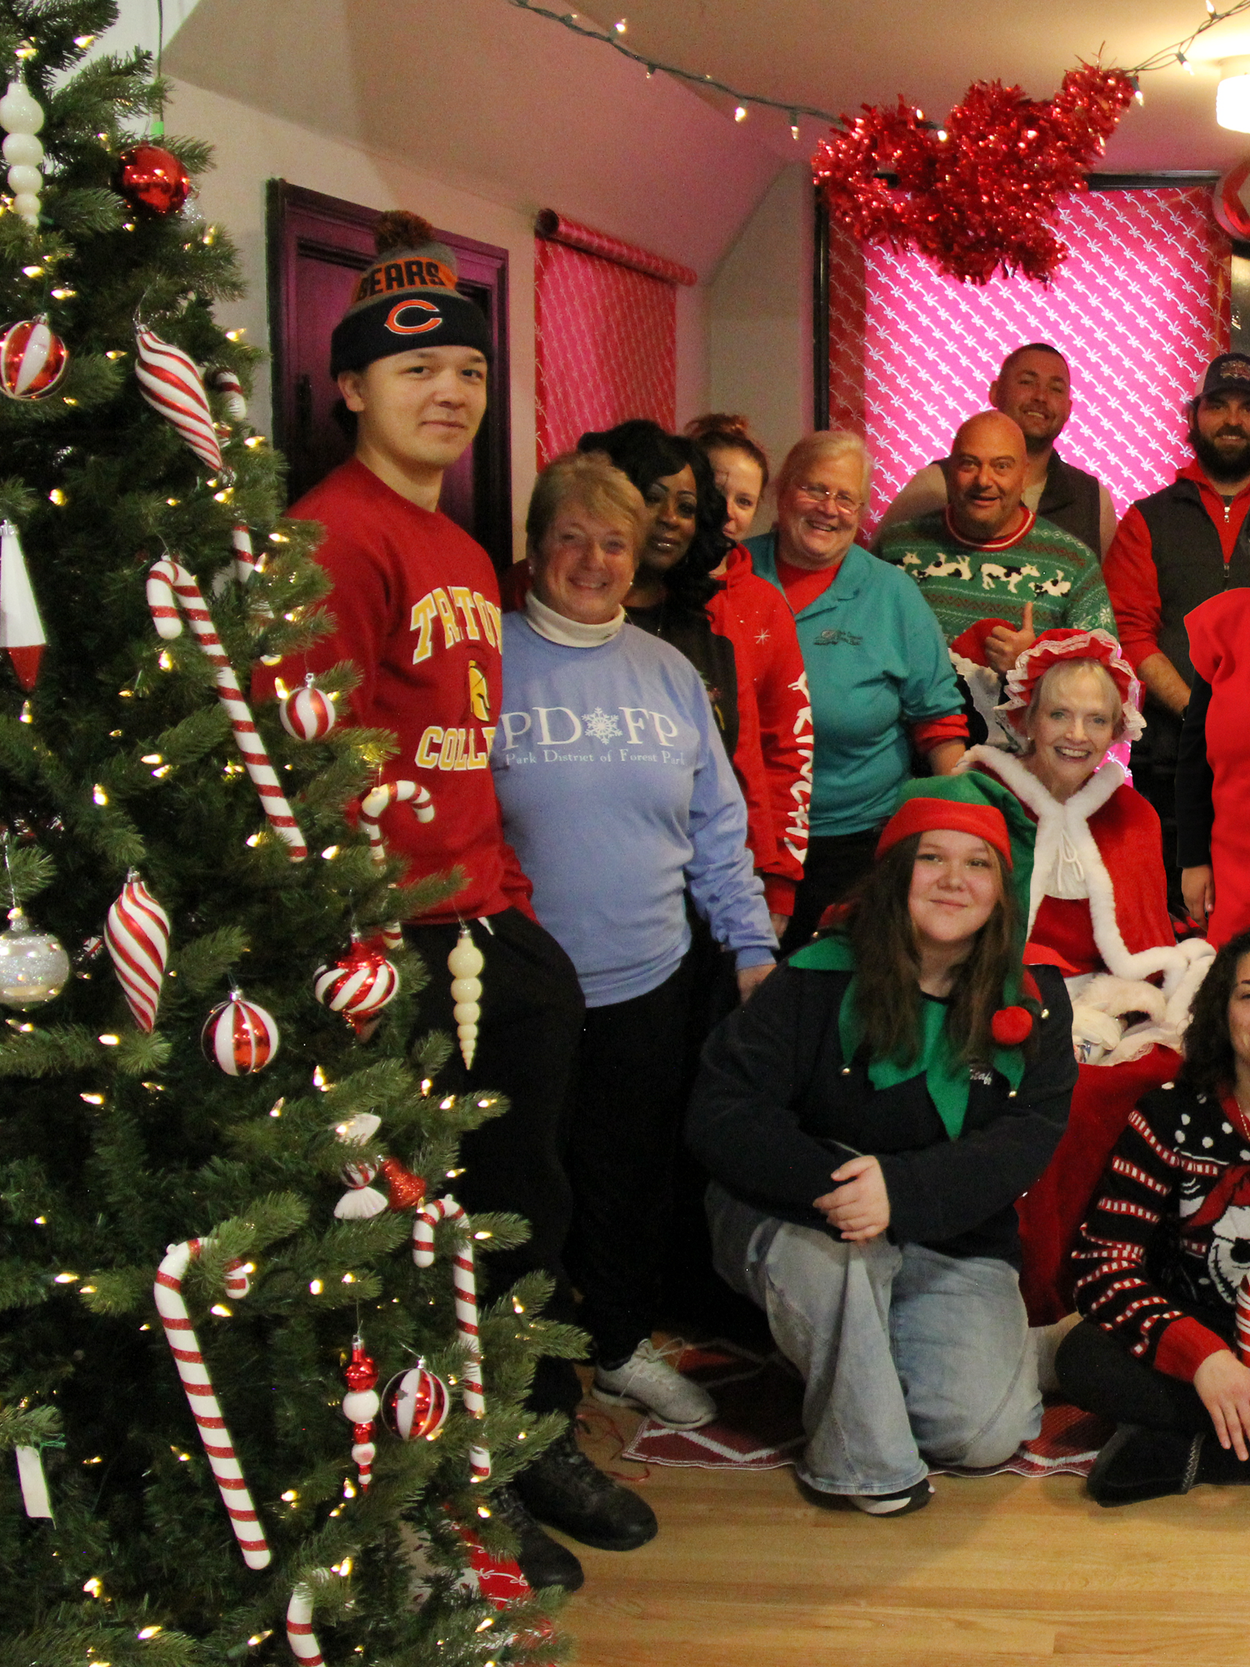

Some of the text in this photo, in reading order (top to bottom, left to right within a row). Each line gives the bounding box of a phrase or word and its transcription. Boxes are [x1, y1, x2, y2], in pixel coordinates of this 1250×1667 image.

[506, 748, 685, 766] Park District of Forest Park
